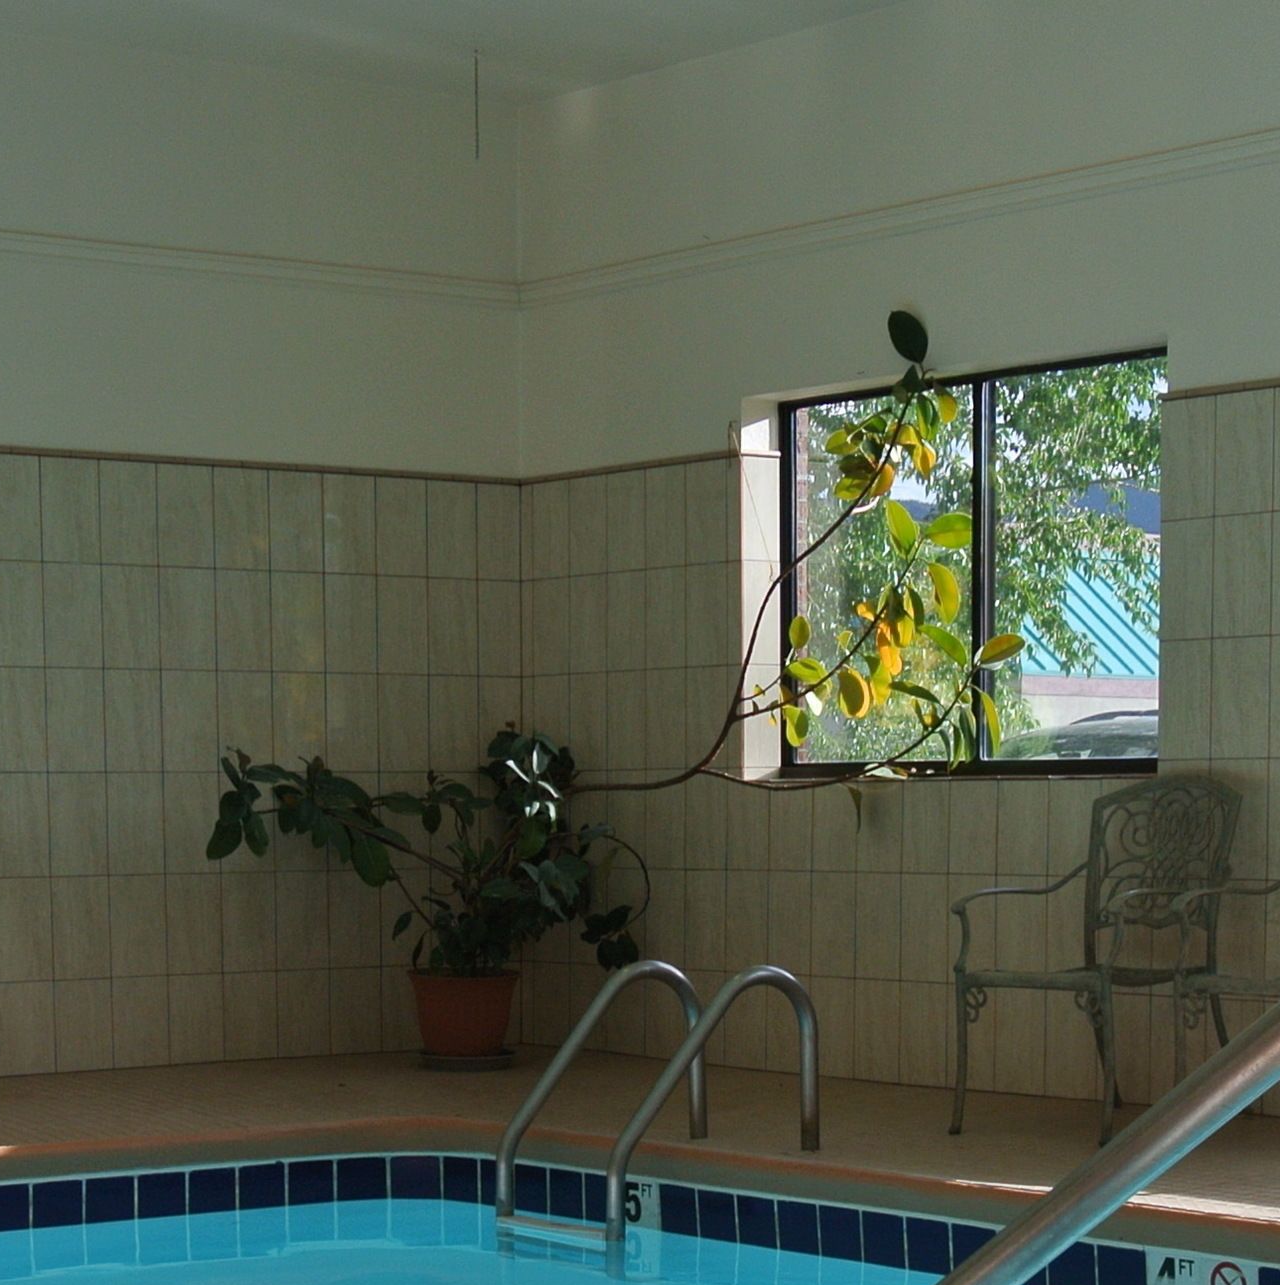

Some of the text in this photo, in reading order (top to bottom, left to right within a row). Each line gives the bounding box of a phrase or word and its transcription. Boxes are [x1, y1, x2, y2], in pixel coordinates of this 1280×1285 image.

[624, 1181, 653, 1223] 5 FT
[1179, 1258, 1195, 1277] FT
